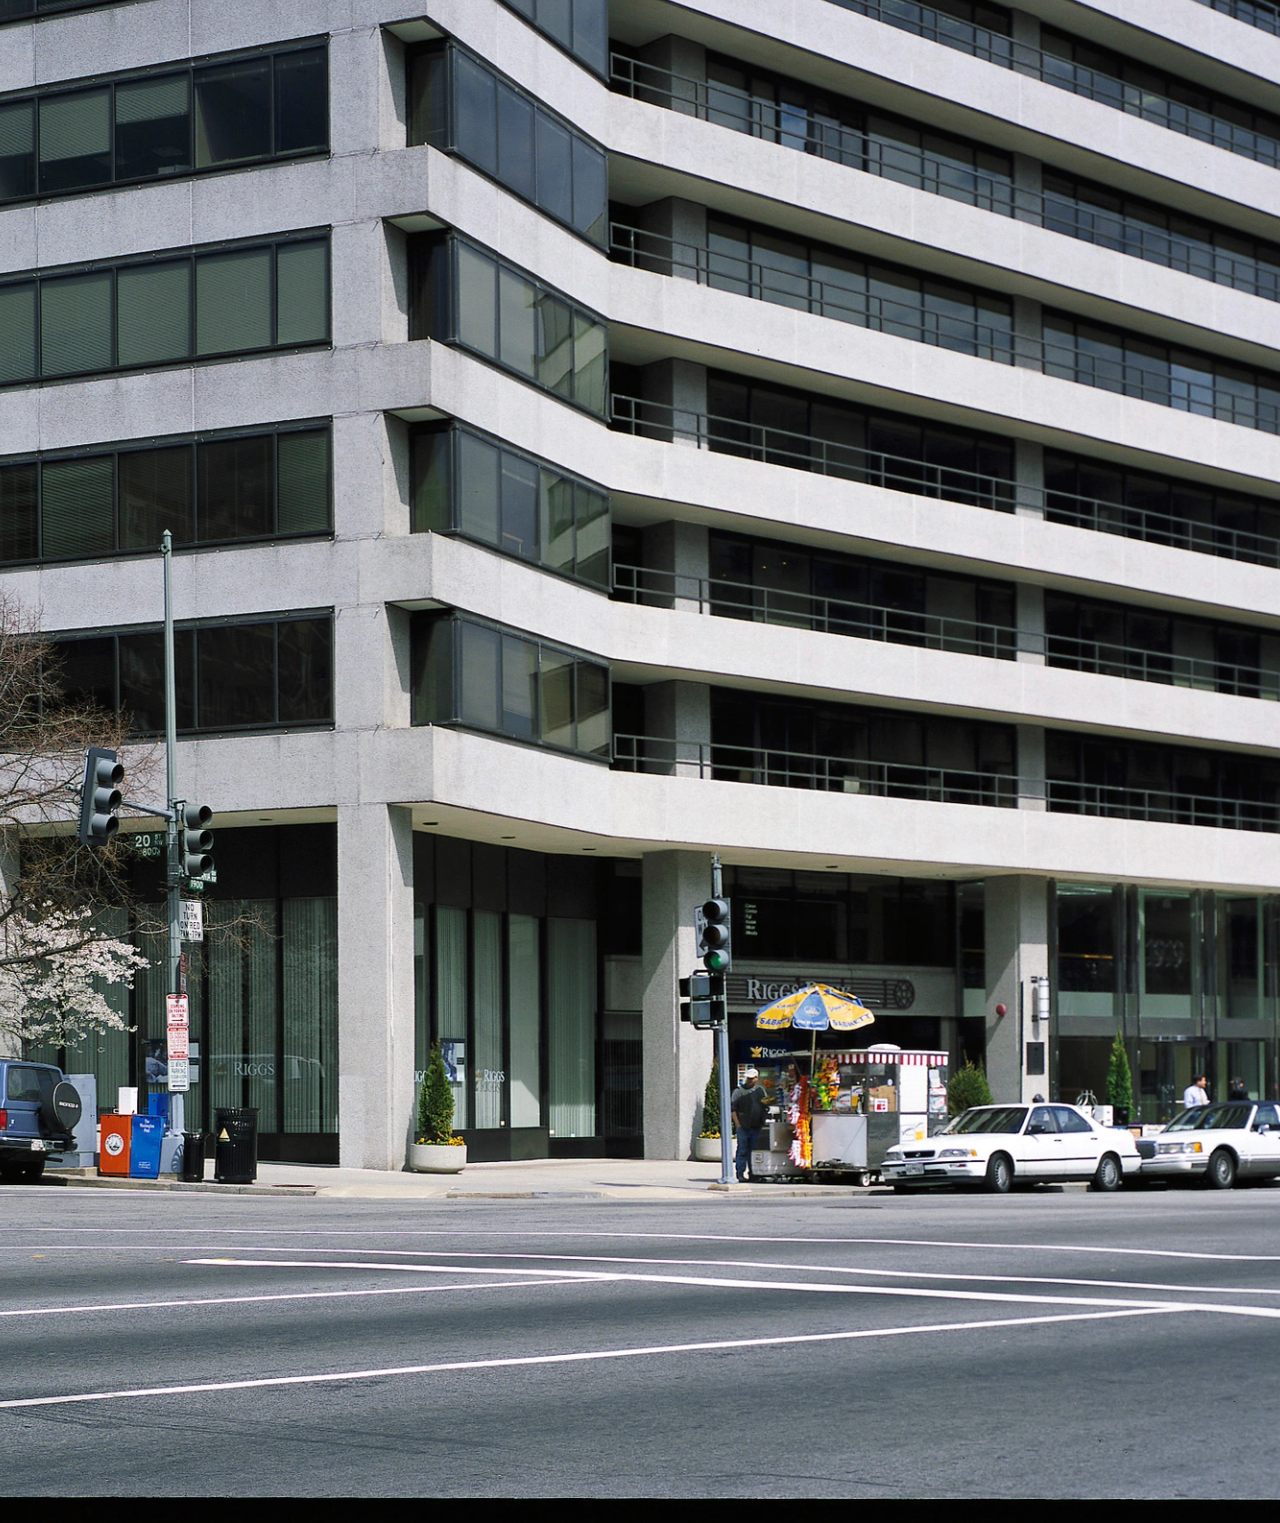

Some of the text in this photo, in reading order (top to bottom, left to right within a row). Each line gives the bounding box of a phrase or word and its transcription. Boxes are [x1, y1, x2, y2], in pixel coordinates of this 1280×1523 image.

[135, 834, 151, 848] 20
[190, 880, 204, 890] 1900
[185, 903, 194, 911] NO
[183, 911, 198, 920] TURN
[180, 920, 200, 930] ON RED
[747, 979, 799, 1001] RIGGS
[233, 1061, 275, 1076] RIGGS
[484, 1069, 505, 1083] RIGGS
